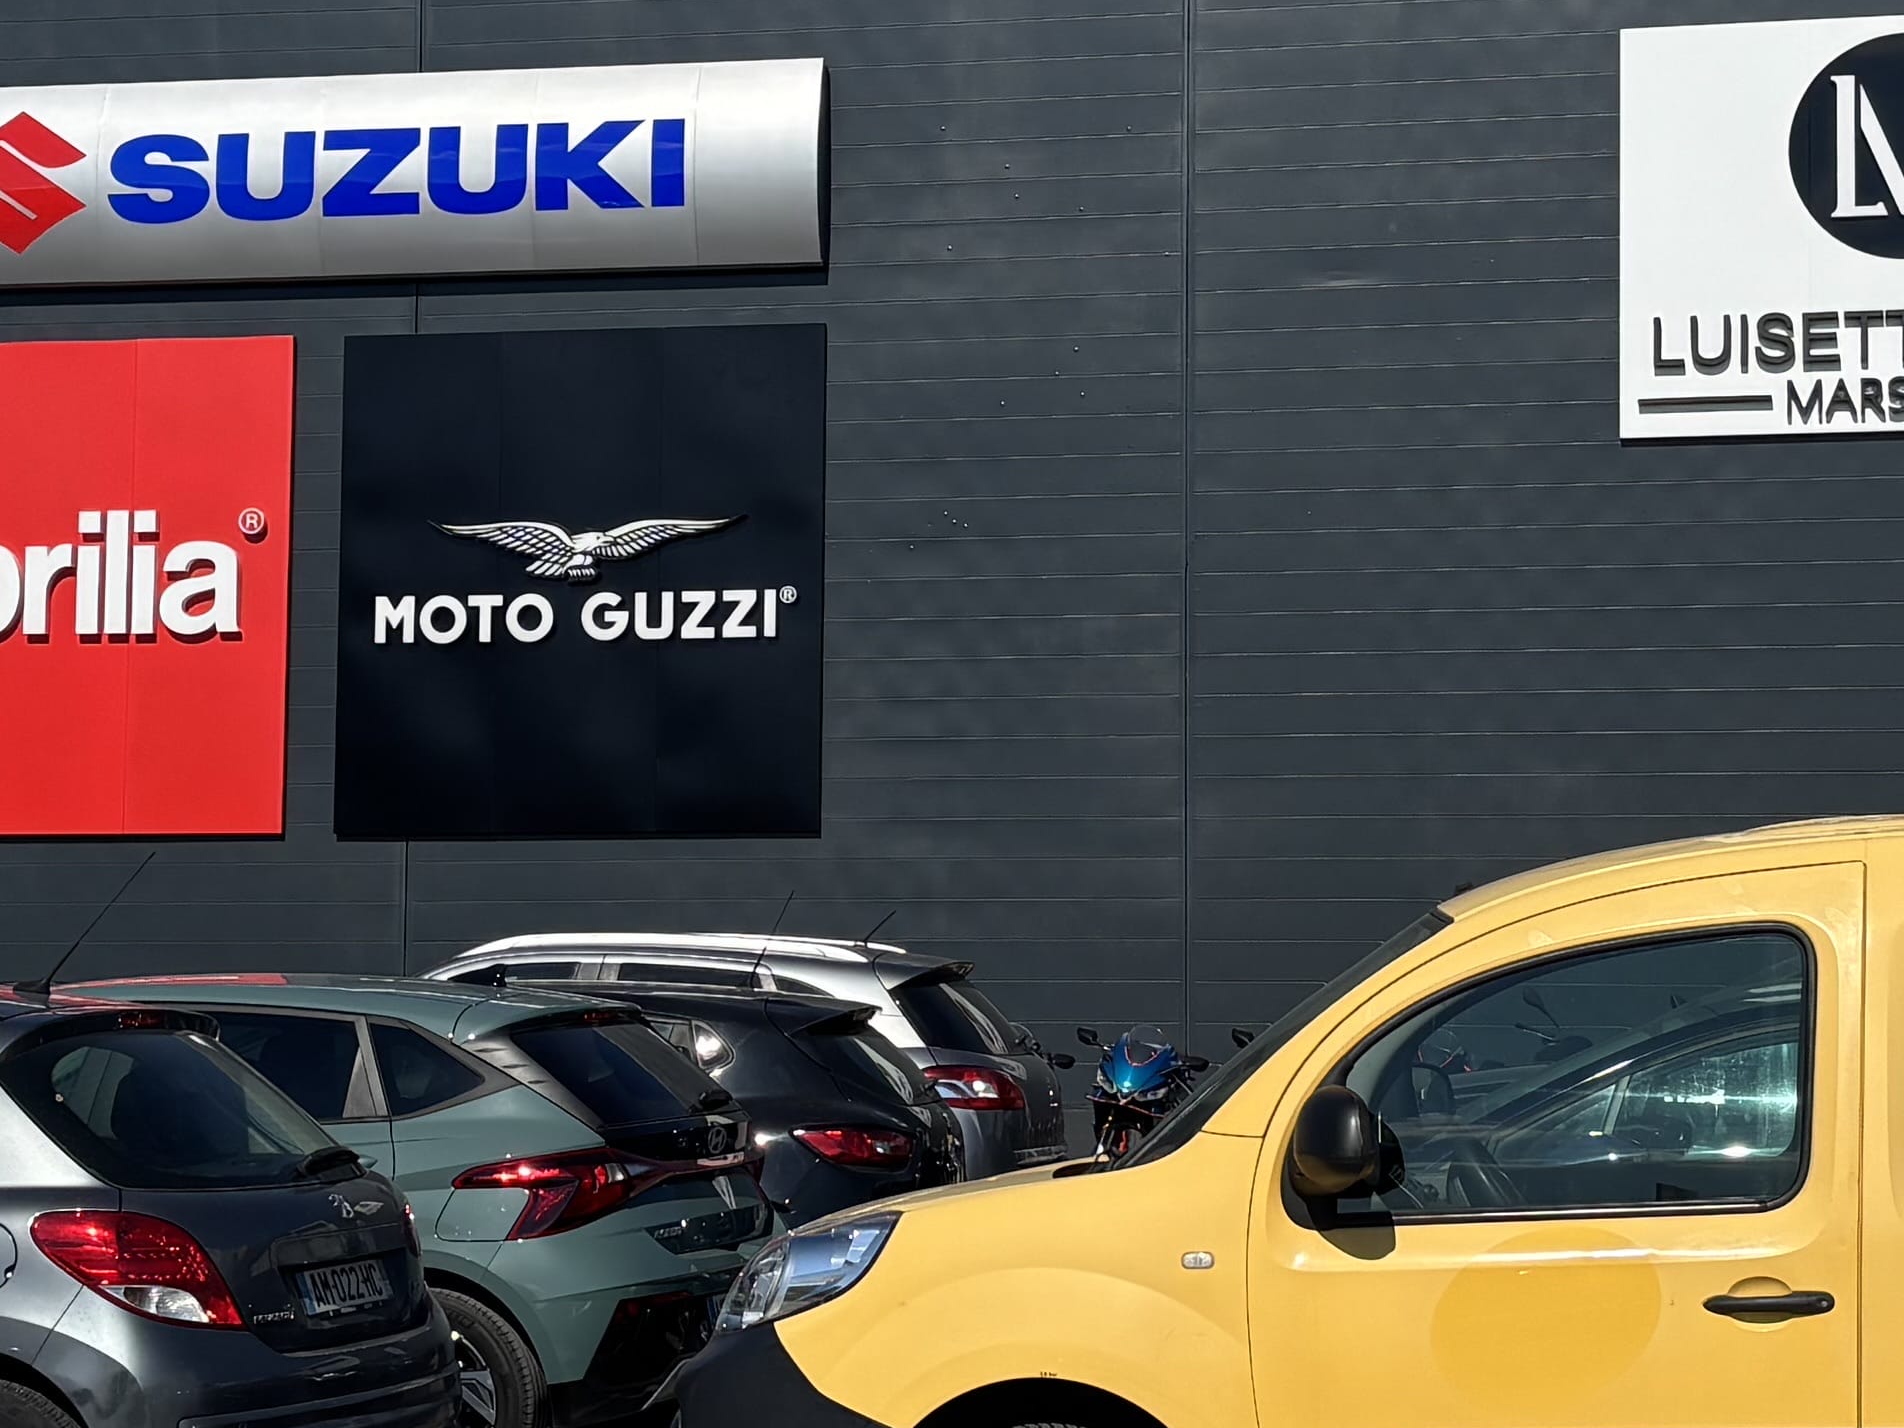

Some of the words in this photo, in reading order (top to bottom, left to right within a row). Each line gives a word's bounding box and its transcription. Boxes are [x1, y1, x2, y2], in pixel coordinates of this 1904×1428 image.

[107, 117, 686, 224] SUZUKI
[372, 591, 554, 646] MOTO
[579, 588, 779, 642] GUZZI
